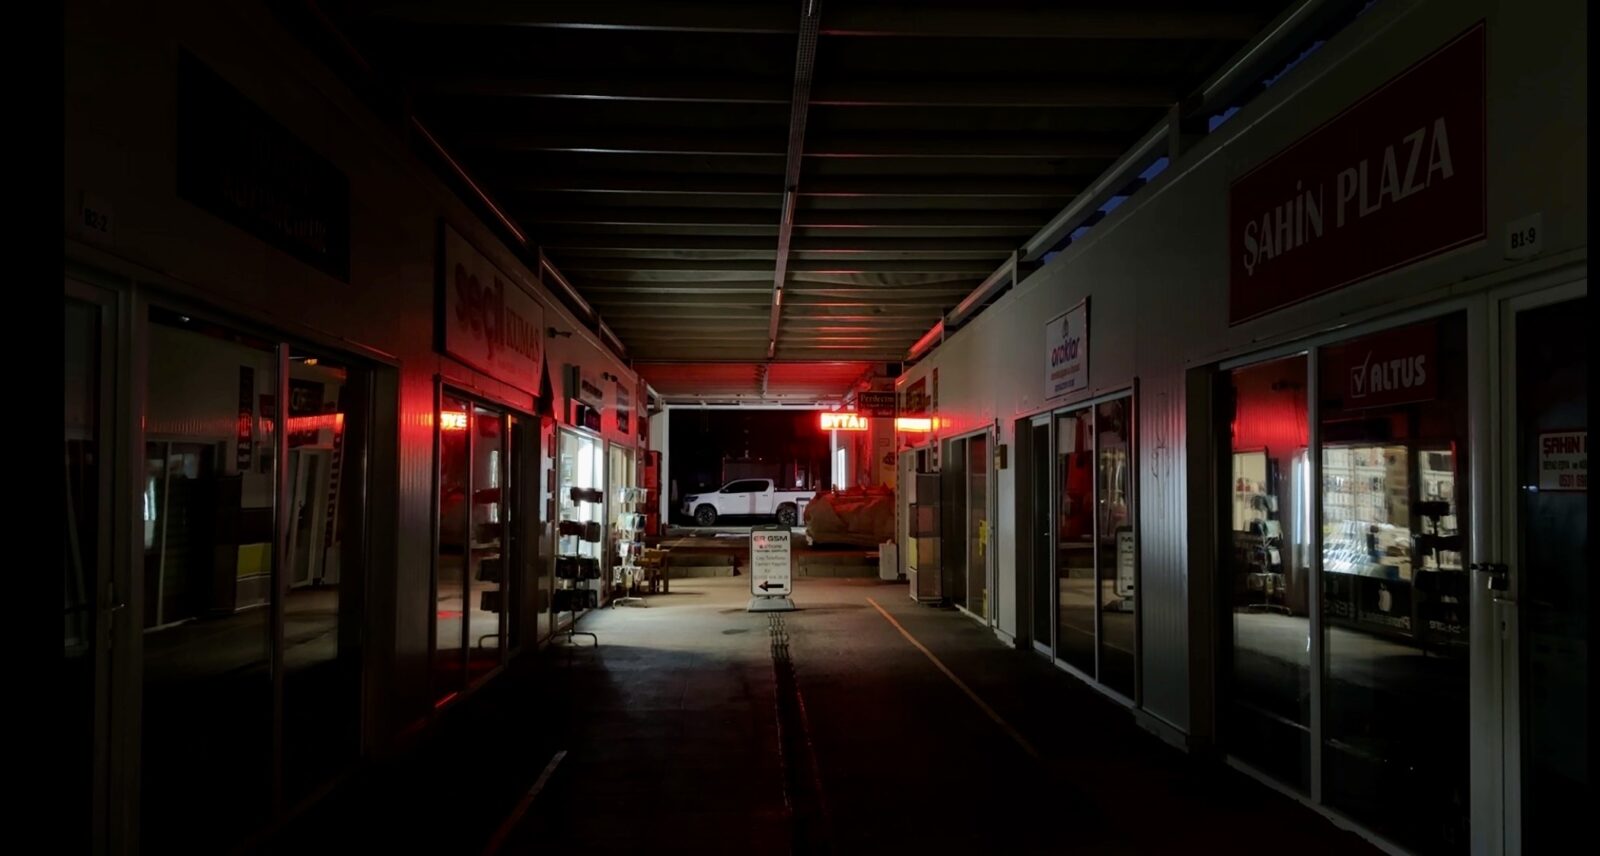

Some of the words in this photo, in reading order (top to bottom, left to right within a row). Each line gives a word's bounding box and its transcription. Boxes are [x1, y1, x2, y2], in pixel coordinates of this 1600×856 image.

[1242, 179, 1325, 278] ŞAHİN
[1335, 115, 1456, 229] PLAZA
[84, 207, 108, 233] B2-2
[1510, 227, 1537, 250] B1-9
[1370, 353, 1428, 393] ALTUS
